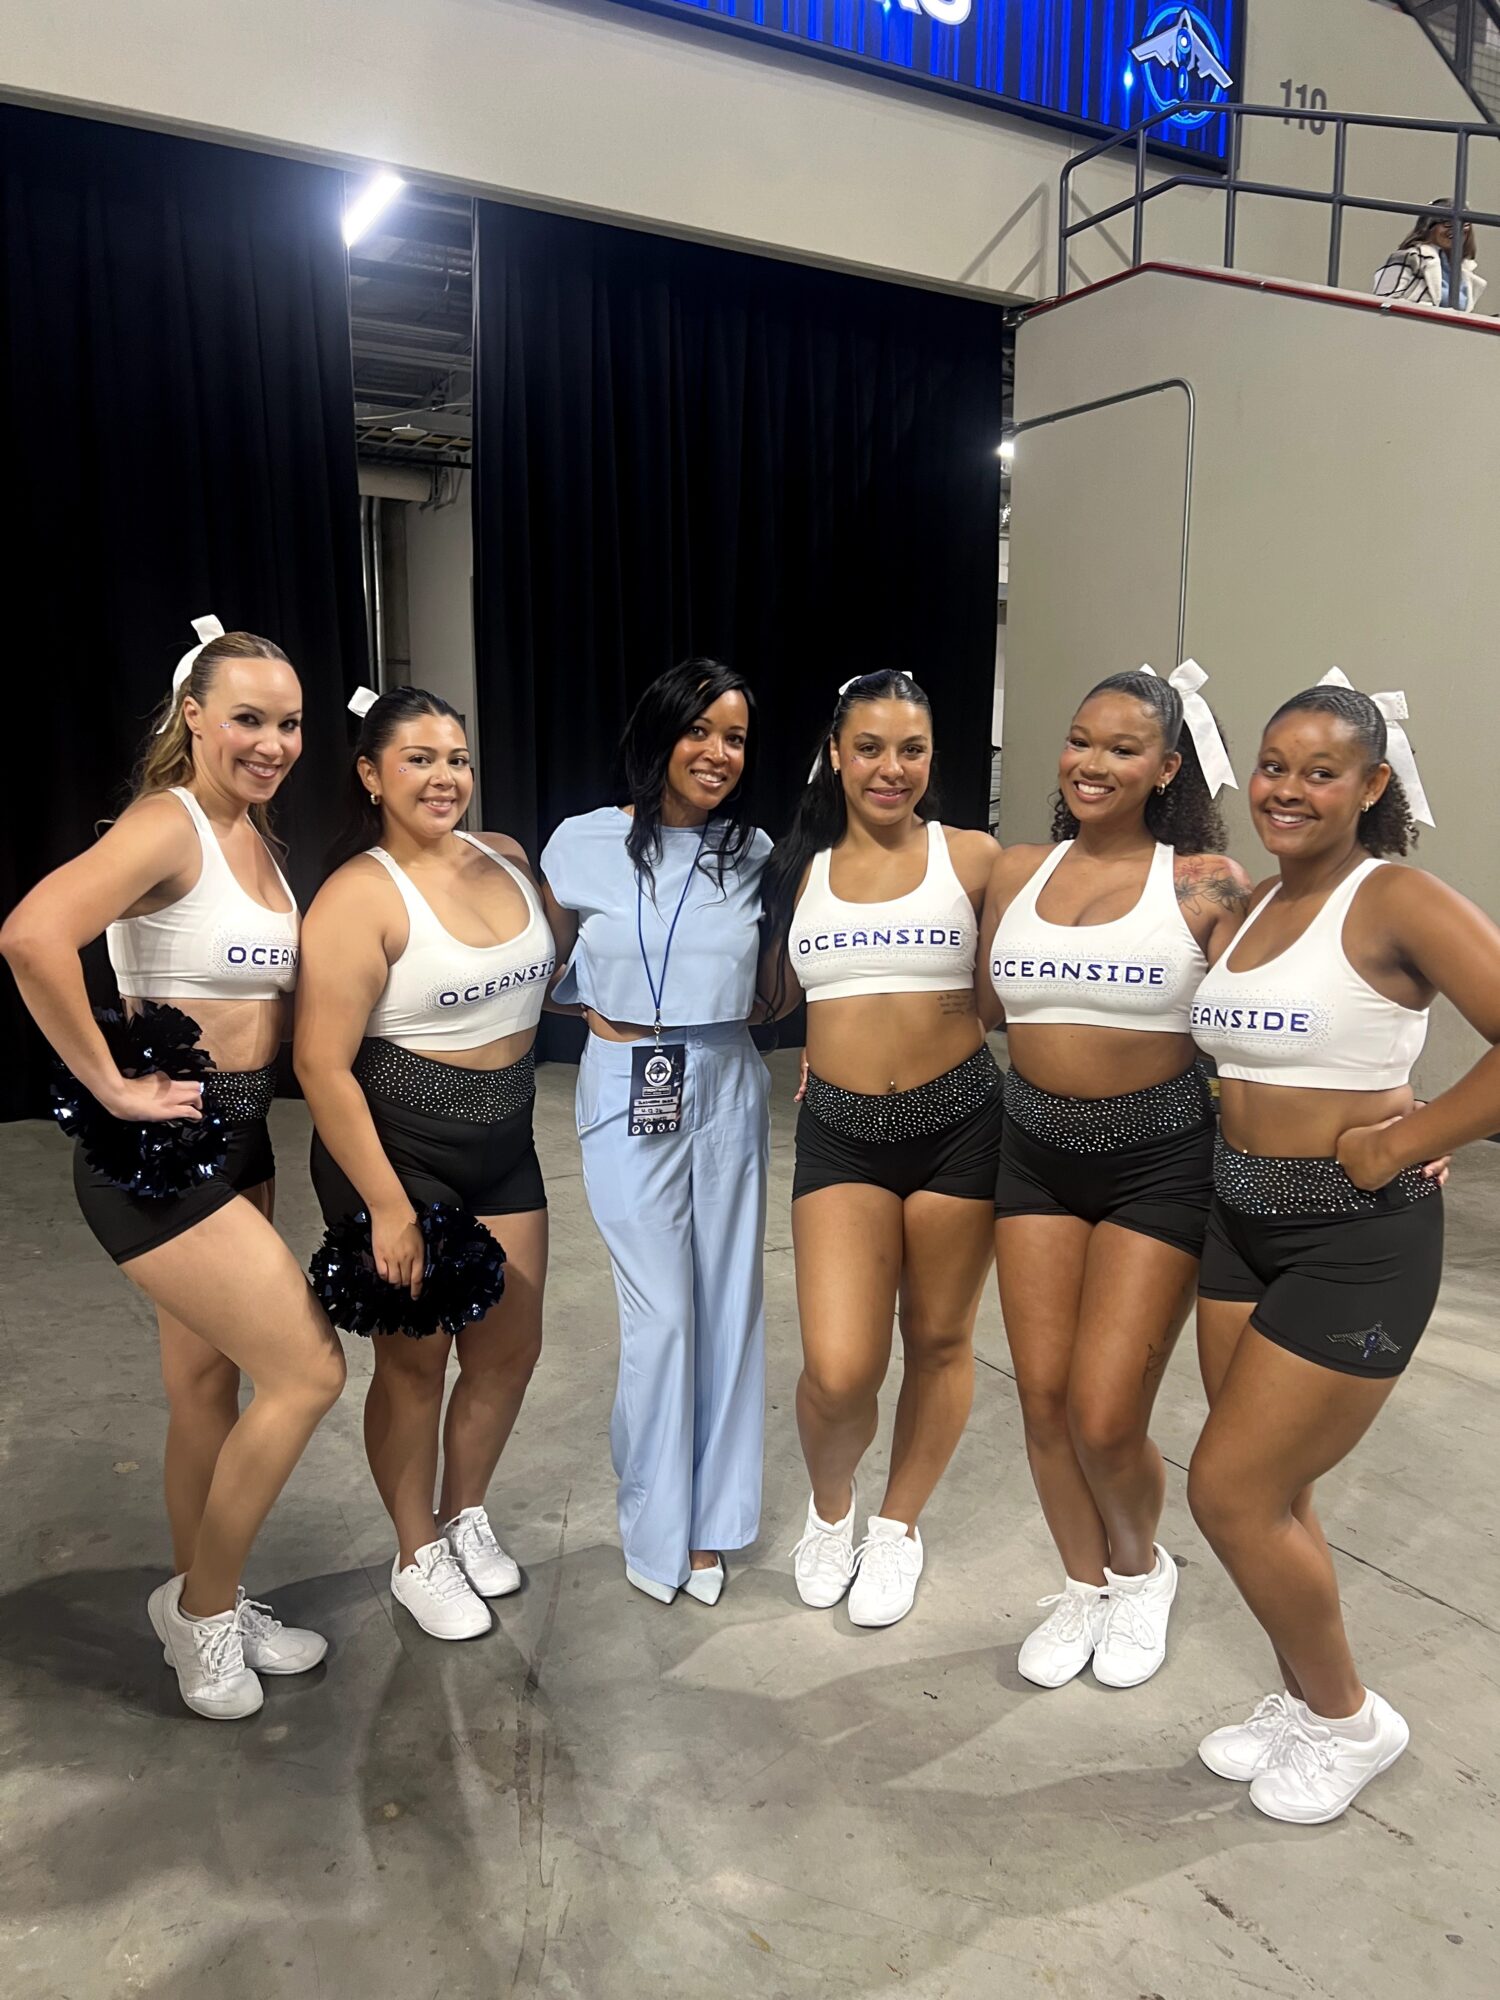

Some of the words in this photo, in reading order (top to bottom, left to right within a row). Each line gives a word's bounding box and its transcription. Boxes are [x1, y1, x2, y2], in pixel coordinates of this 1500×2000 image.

[1280, 78, 1327, 135] 110
[799, 929, 961, 955] OCEANSIDE
[993, 960, 1165, 985] OCEANSIDE
